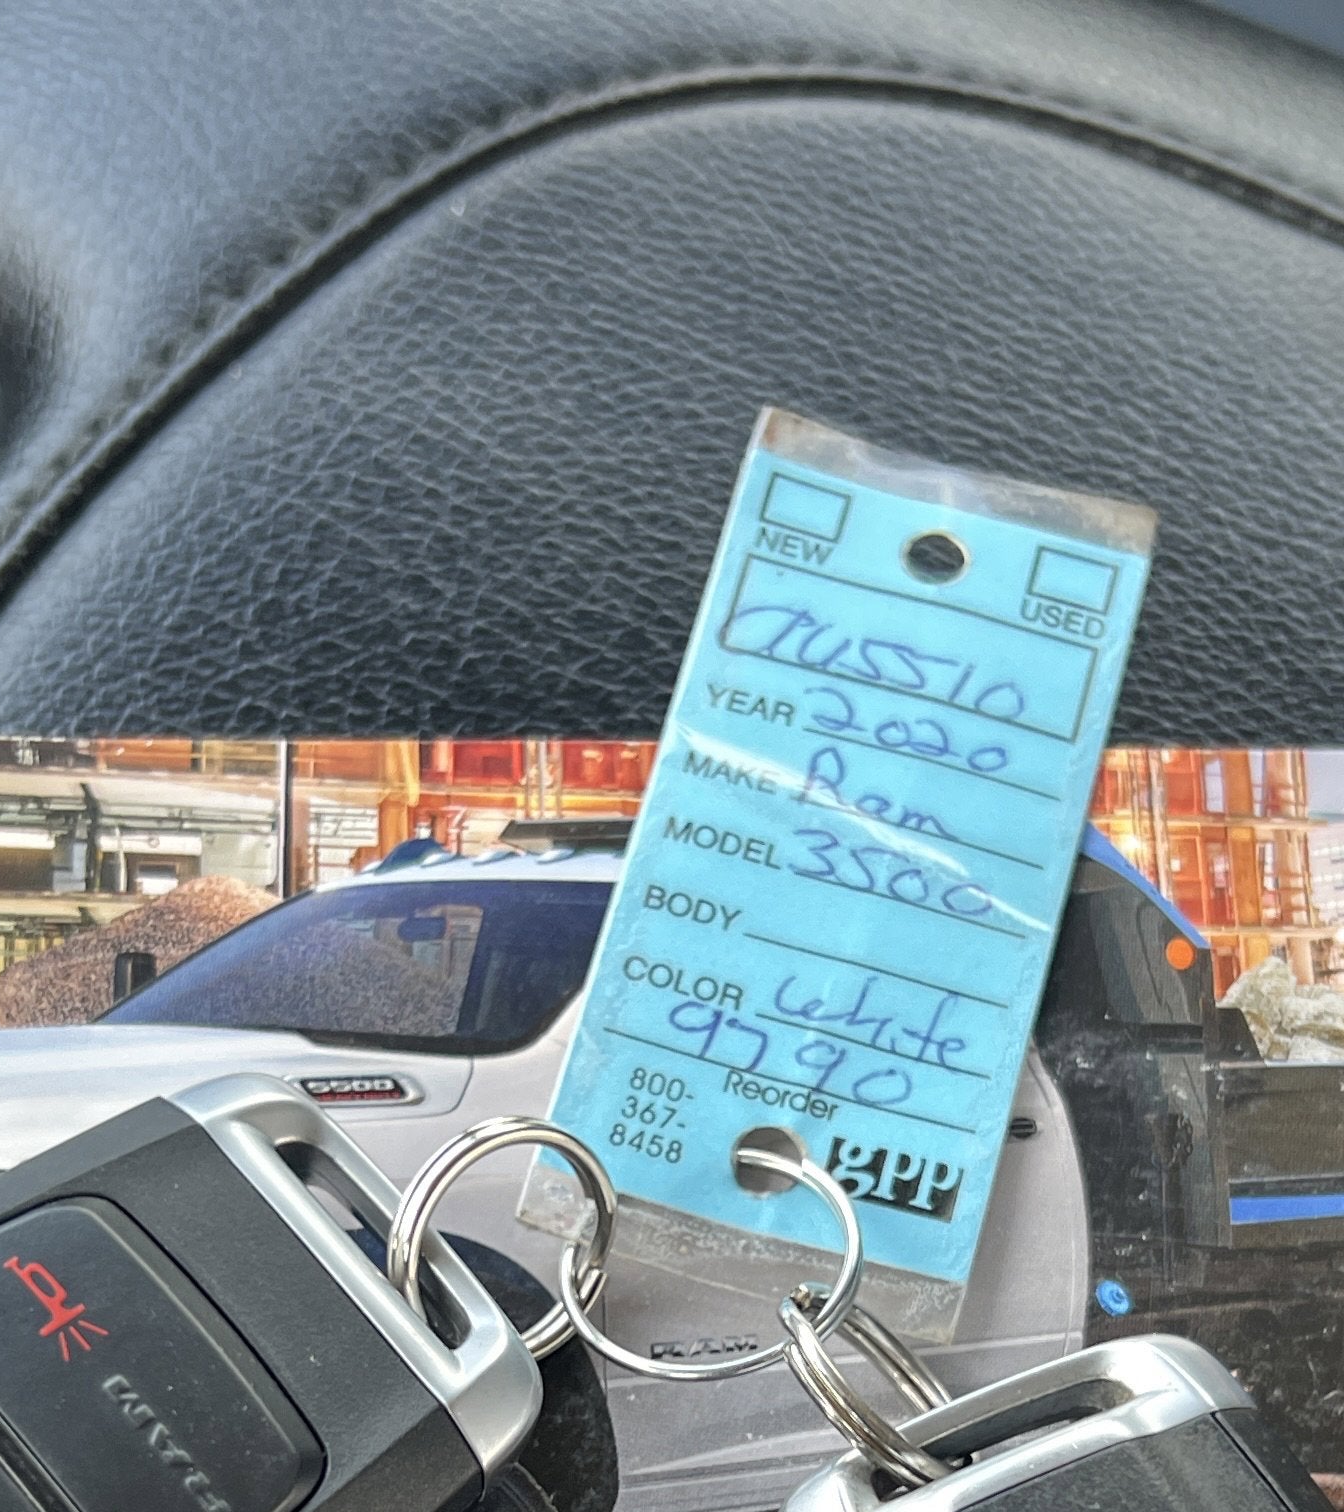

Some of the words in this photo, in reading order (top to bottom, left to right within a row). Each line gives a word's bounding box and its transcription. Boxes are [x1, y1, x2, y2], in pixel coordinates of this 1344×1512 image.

[753, 527, 836, 566] NEW
[1019, 599, 1107, 640] USED
[706, 683, 797, 728] YEAR
[803, 686, 1008, 773] 2020
[682, 750, 780, 796] MAKE
[662, 815, 781, 871] MODEL
[788, 829, 993, 917] 3500
[641, 883, 742, 932] BODY
[622, 955, 745, 1011] COLOR
[668, 1000, 913, 1105] 9790
[628, 1066, 695, 1102] 800-
[722, 1069, 839, 1122] Reorder
[620, 1096, 687, 1130] 367-
[608, 1123, 684, 1165] 8458
